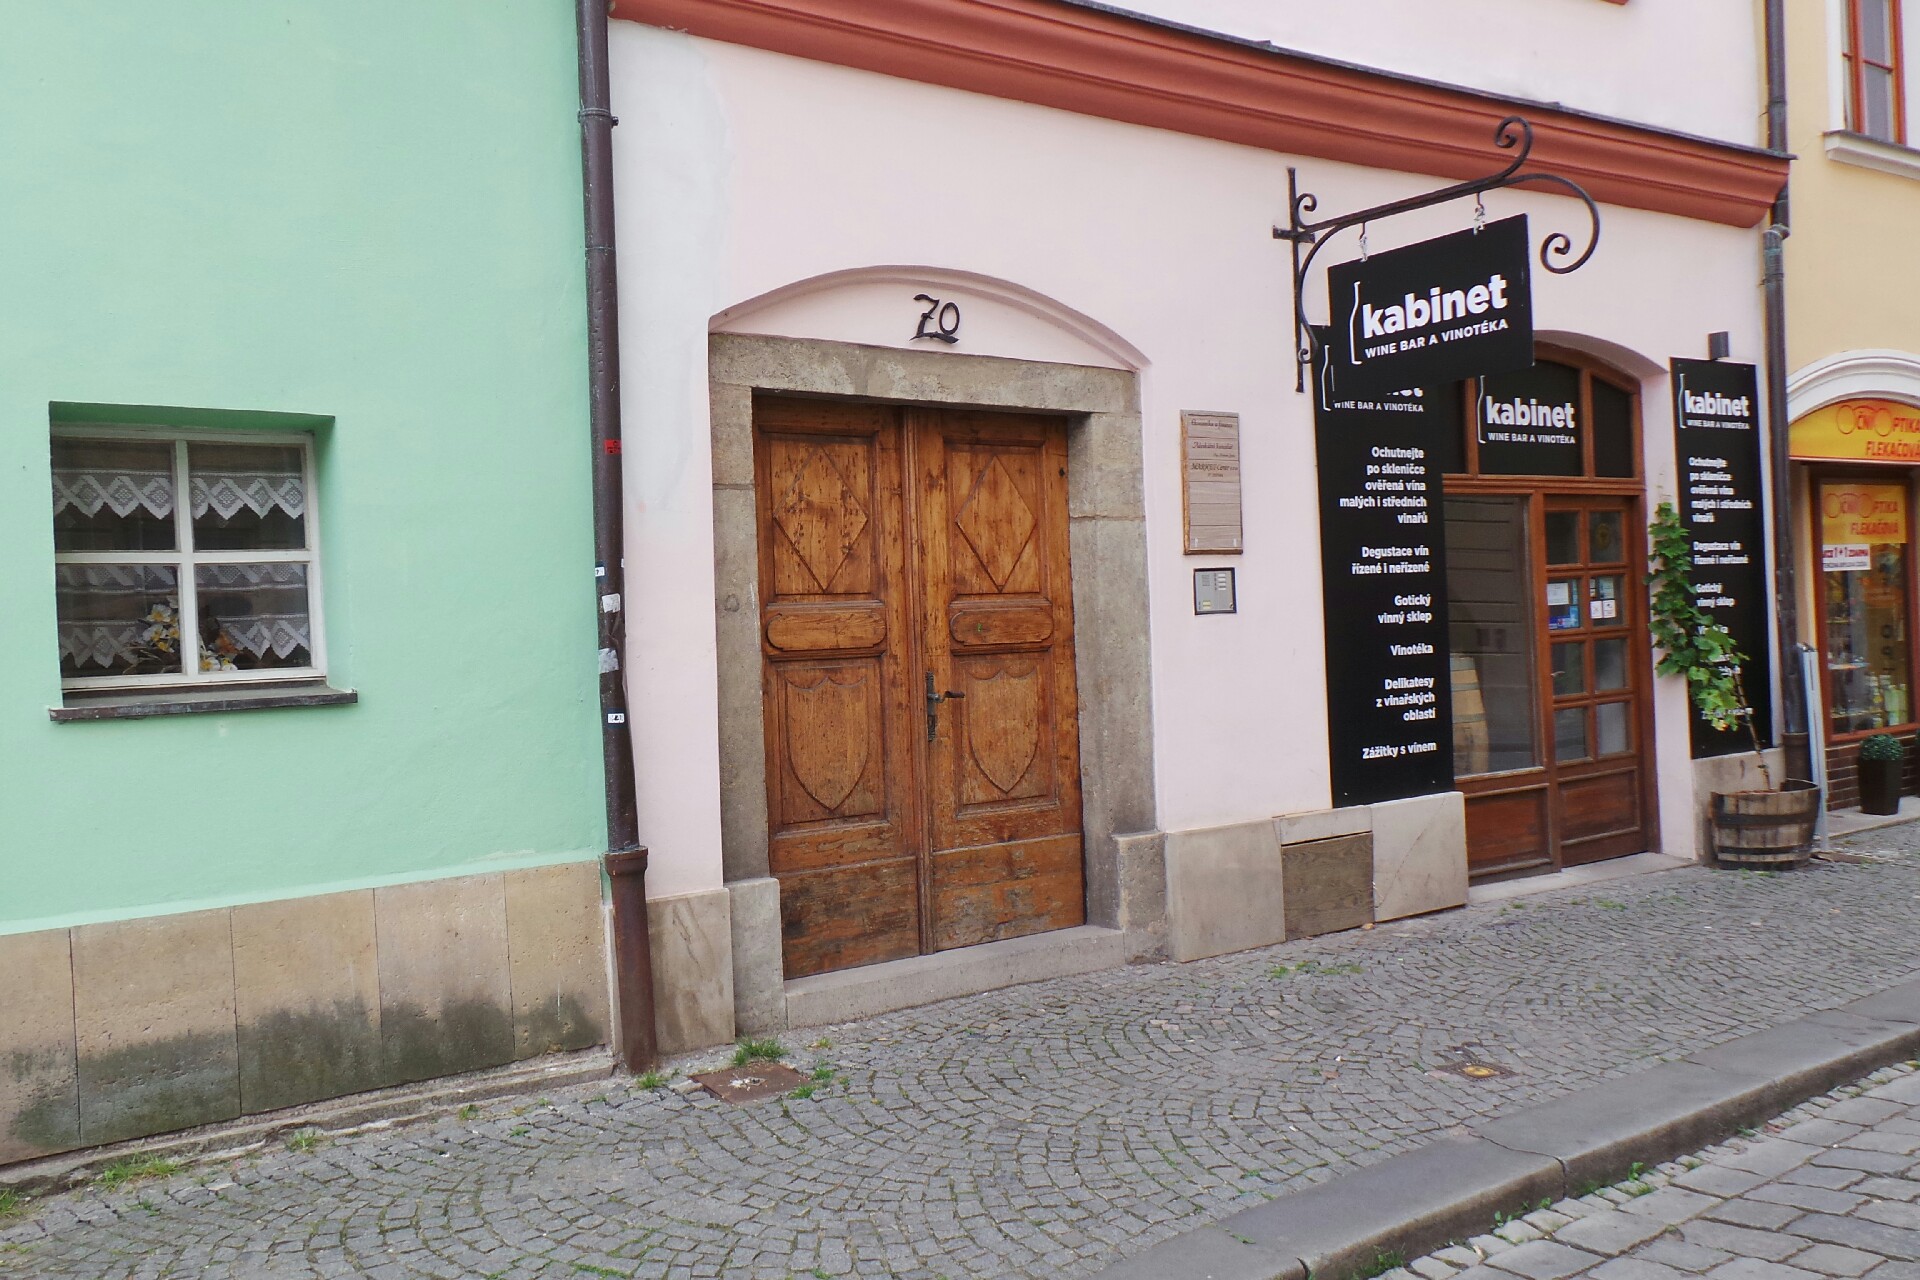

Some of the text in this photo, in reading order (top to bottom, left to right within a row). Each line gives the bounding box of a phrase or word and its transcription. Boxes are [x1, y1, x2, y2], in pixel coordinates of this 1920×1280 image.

[1363, 274, 1508, 338] kabinet
[1365, 318, 1508, 359] WINE BAR A VINOTÉKA
[1357, 401, 1374, 410] BAR
[1376, 402, 1382, 410] A
[1384, 402, 1424, 412] VINOTÉKA
[1684, 390, 1750, 417] kabinet
[1486, 395, 1575, 428] kabinet
[1488, 432, 1576, 444] WINE BAR A VINOTÉKA
[1371, 446, 1425, 460] Ochutnejte
[1366, 463, 1426, 475] po skleničce
[1365, 479, 1426, 491] ověřená vína
[1339, 495, 1376, 509] malých
[1383, 496, 1428, 507] středních
[1397, 511, 1428, 523] vinařů
[1361, 545, 1429, 559] Degustace vín
[1352, 563, 1382, 575] řízené
[1389, 561, 1430, 573] neřízené
[1394, 593, 1431, 606] Gotický
[1378, 611, 1432, 624] vinný sklep
[1390, 642, 1434, 656] Vinotéka
[1384, 676, 1434, 690] Delikatesy
[1376, 691, 1436, 708] z vinařských
[1402, 707, 1436, 721] oblastí
[1362, 745, 1399, 760] Zážitky
[1408, 741, 1437, 754] vínem
